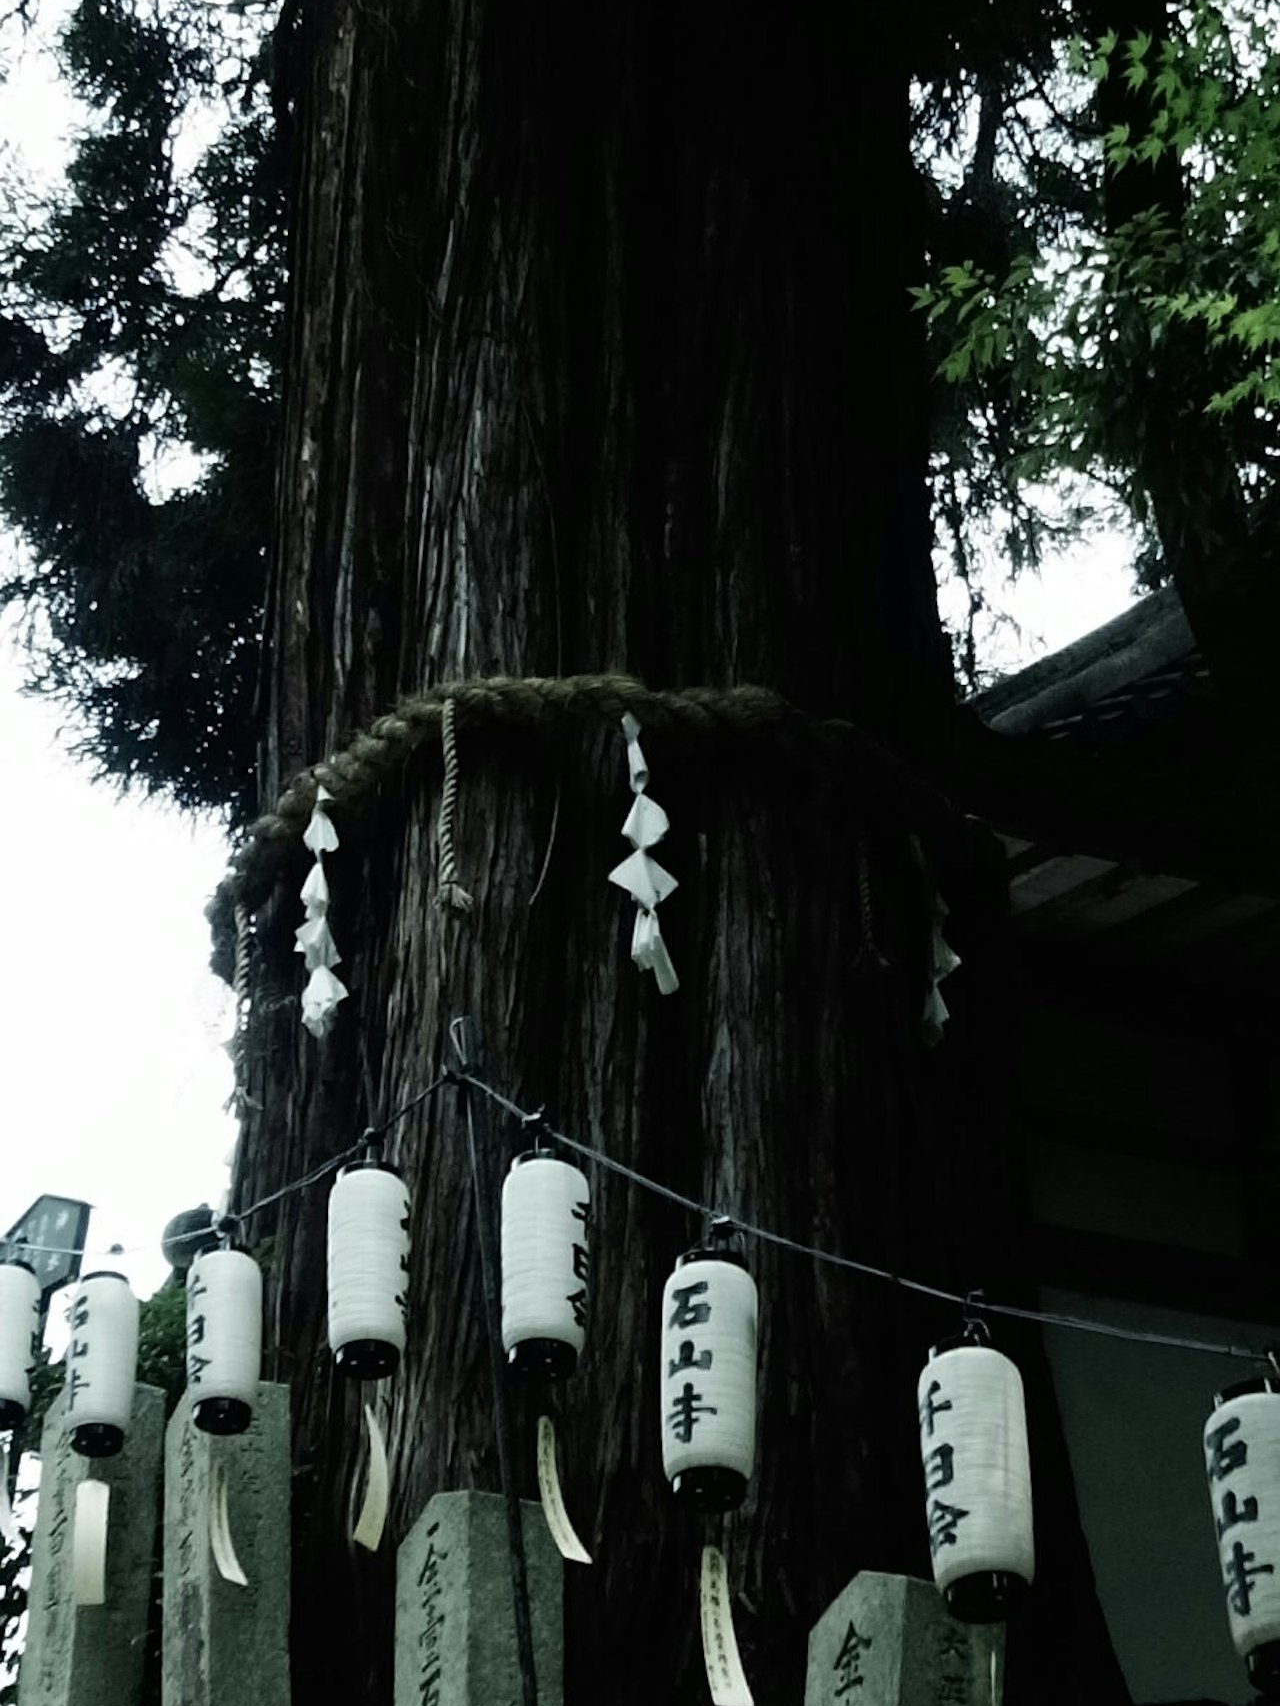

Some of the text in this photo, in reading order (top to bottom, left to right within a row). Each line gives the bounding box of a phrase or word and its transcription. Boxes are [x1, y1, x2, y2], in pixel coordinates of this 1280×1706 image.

[668, 1281, 717, 1444] 石山寺
[920, 1380, 970, 1558] 千日会
[1205, 1417, 1274, 1618] 石山寺
